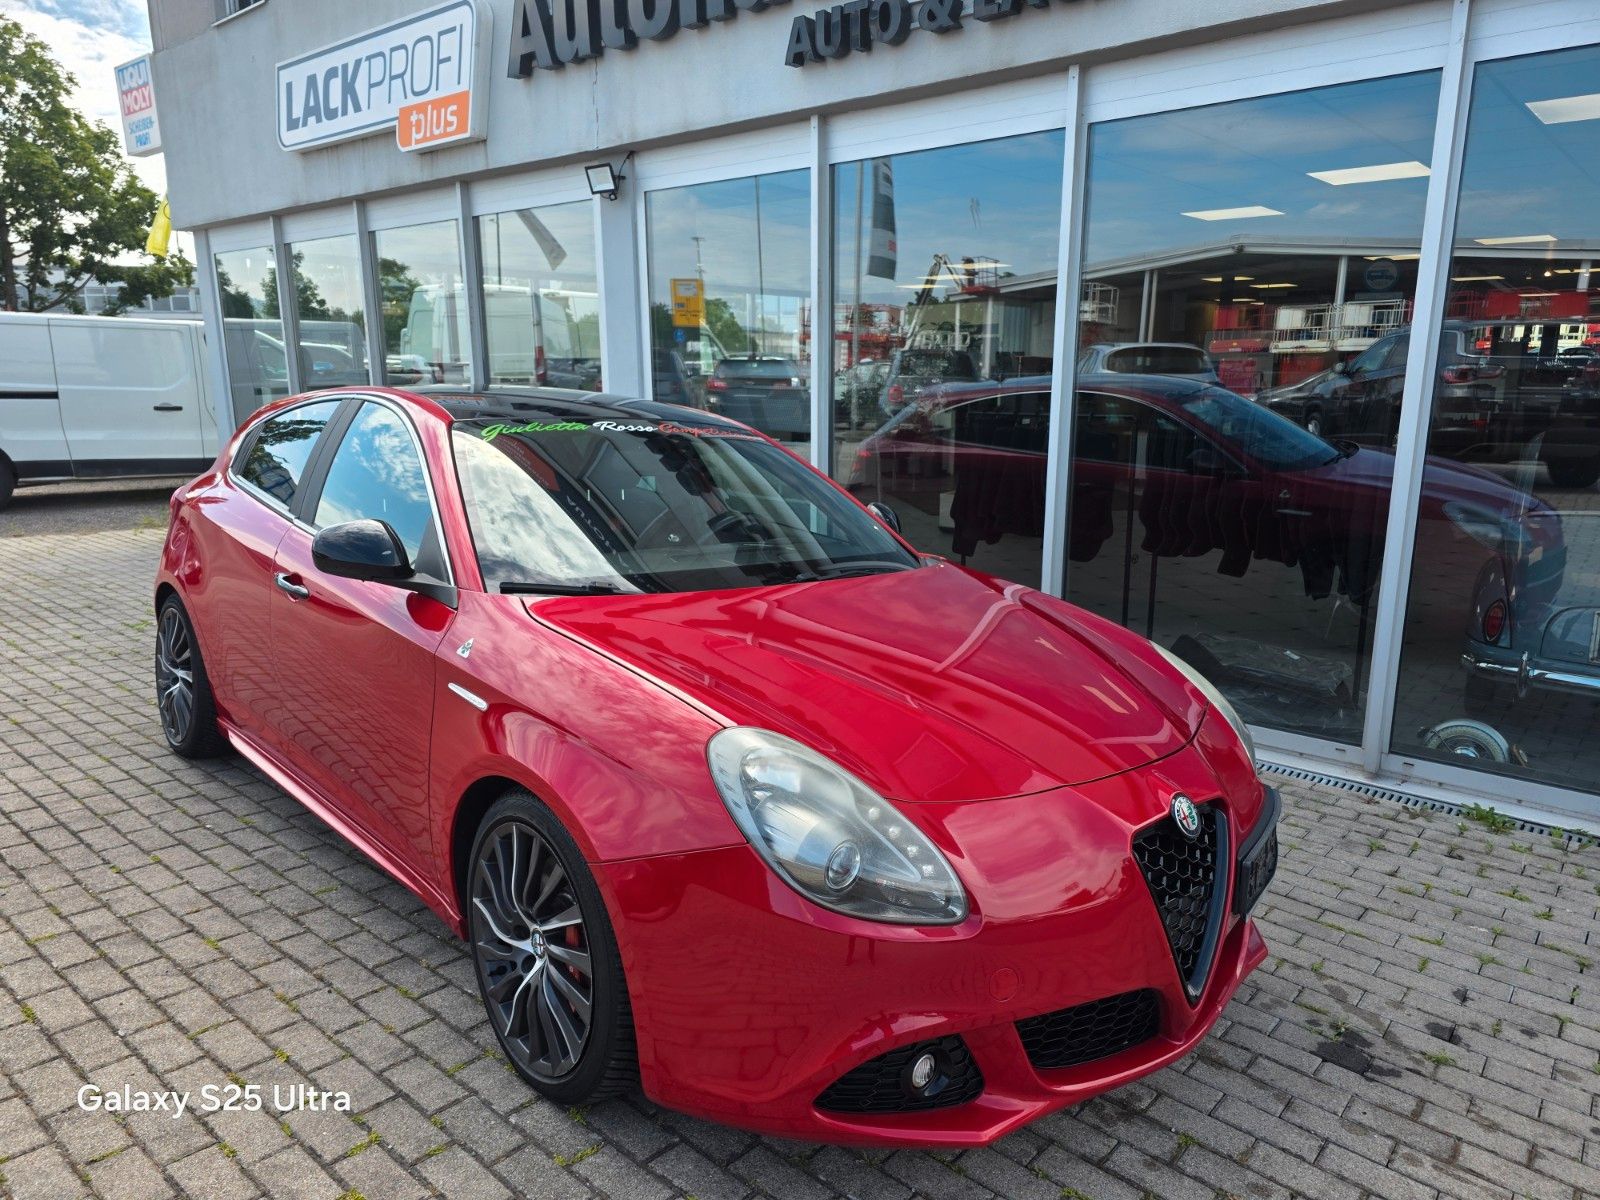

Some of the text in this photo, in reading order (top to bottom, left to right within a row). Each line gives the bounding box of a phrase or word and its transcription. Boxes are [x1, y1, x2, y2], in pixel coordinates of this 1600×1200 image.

[784, 0, 912, 68] AUTO
[286, 24, 463, 132] LACKPROFI
[122, 85, 151, 115] MOLY
[410, 104, 458, 146] plus
[481, 421, 592, 443] Giulietta
[593, 420, 659, 432] Rosso
